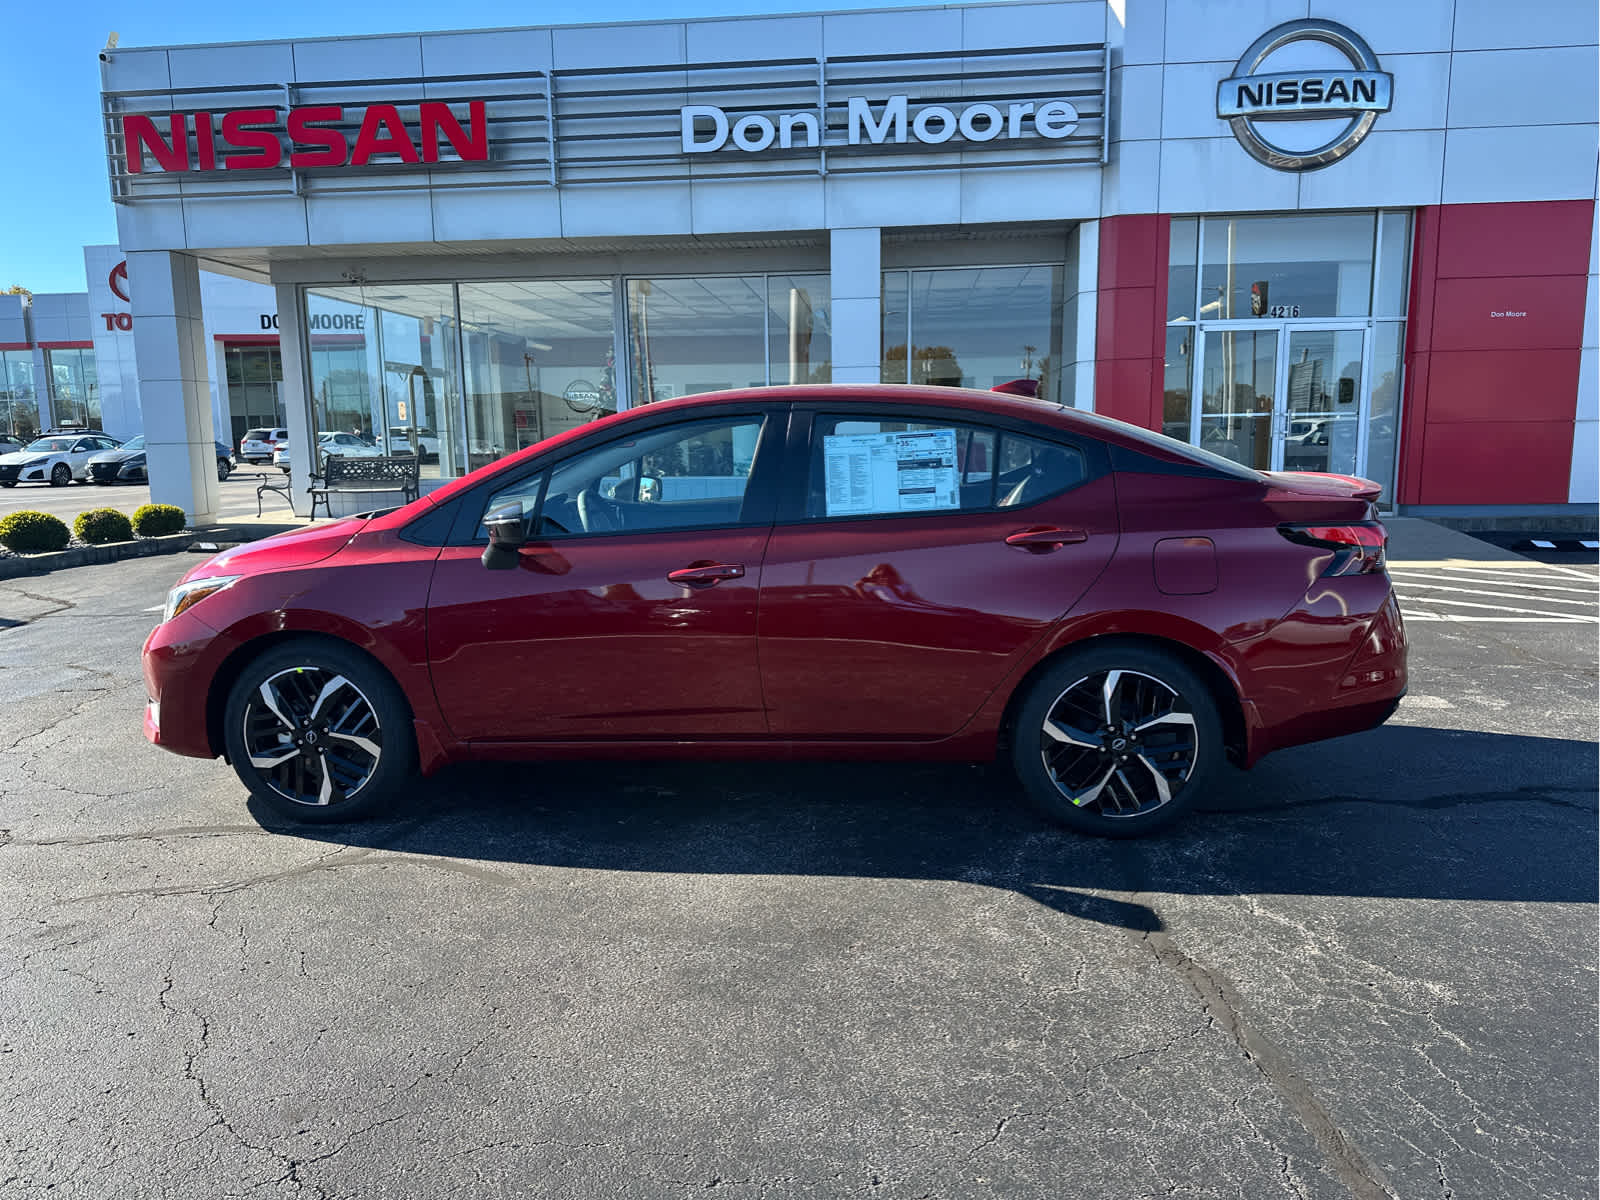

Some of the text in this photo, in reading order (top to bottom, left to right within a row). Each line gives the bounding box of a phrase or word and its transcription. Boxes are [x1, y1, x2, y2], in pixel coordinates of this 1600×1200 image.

[1236, 78, 1376, 109] NISSAN
[122, 100, 490, 174] NISSAN
[680, 94, 1080, 154] Don Moore
[1270, 304, 1300, 319] 4216
